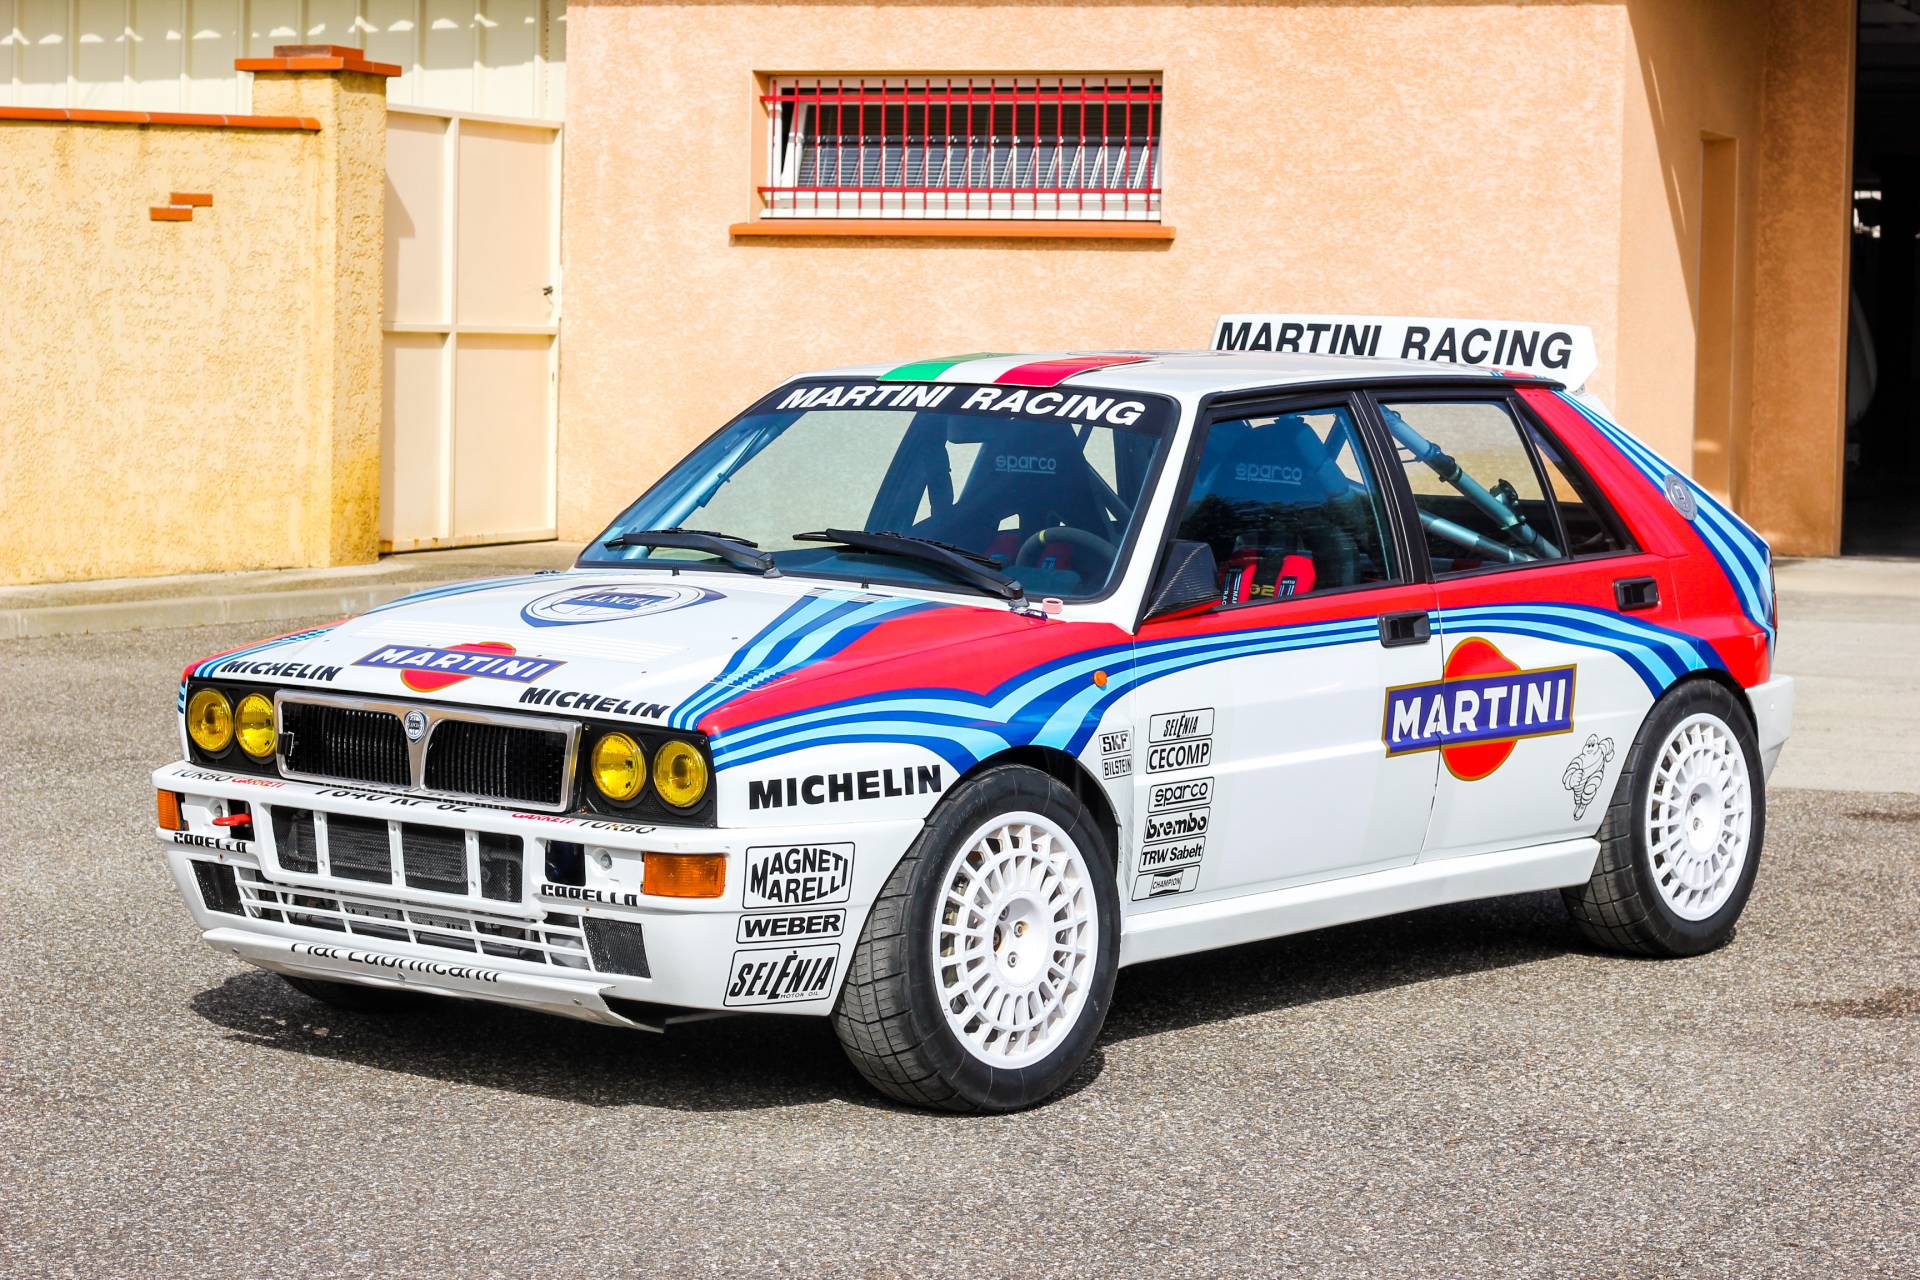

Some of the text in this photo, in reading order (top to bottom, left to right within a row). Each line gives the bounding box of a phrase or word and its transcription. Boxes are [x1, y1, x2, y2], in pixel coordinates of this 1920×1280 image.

[1216, 322, 1574, 369] MARTINI RACING
[776, 385, 1146, 427] MARTINI RACING
[995, 454, 1057, 471] sparco
[1235, 462, 1303, 482] sparco
[219, 660, 344, 682] MICHELIN
[367, 648, 549, 678] MARTINI
[518, 687, 671, 720] MICHELIN
[1391, 678, 1567, 743] MARTINI
[1102, 733, 1129, 753] SKF
[1149, 742, 1210, 770] CECOMP
[1104, 757, 1132, 778] BILSTEIN
[749, 764, 942, 810] MICHELIN
[1154, 782, 1208, 807] sparco
[1146, 812, 1207, 840] brembo
[751, 848, 848, 888] MAGNETI
[1142, 845, 1203, 866] TRW Sabelt
[541, 884, 638, 907] CARELLO
[751, 868, 848, 904] MARELLI
[1152, 876, 1183, 889] CHAMPION
[744, 914, 841, 938] WEBER
